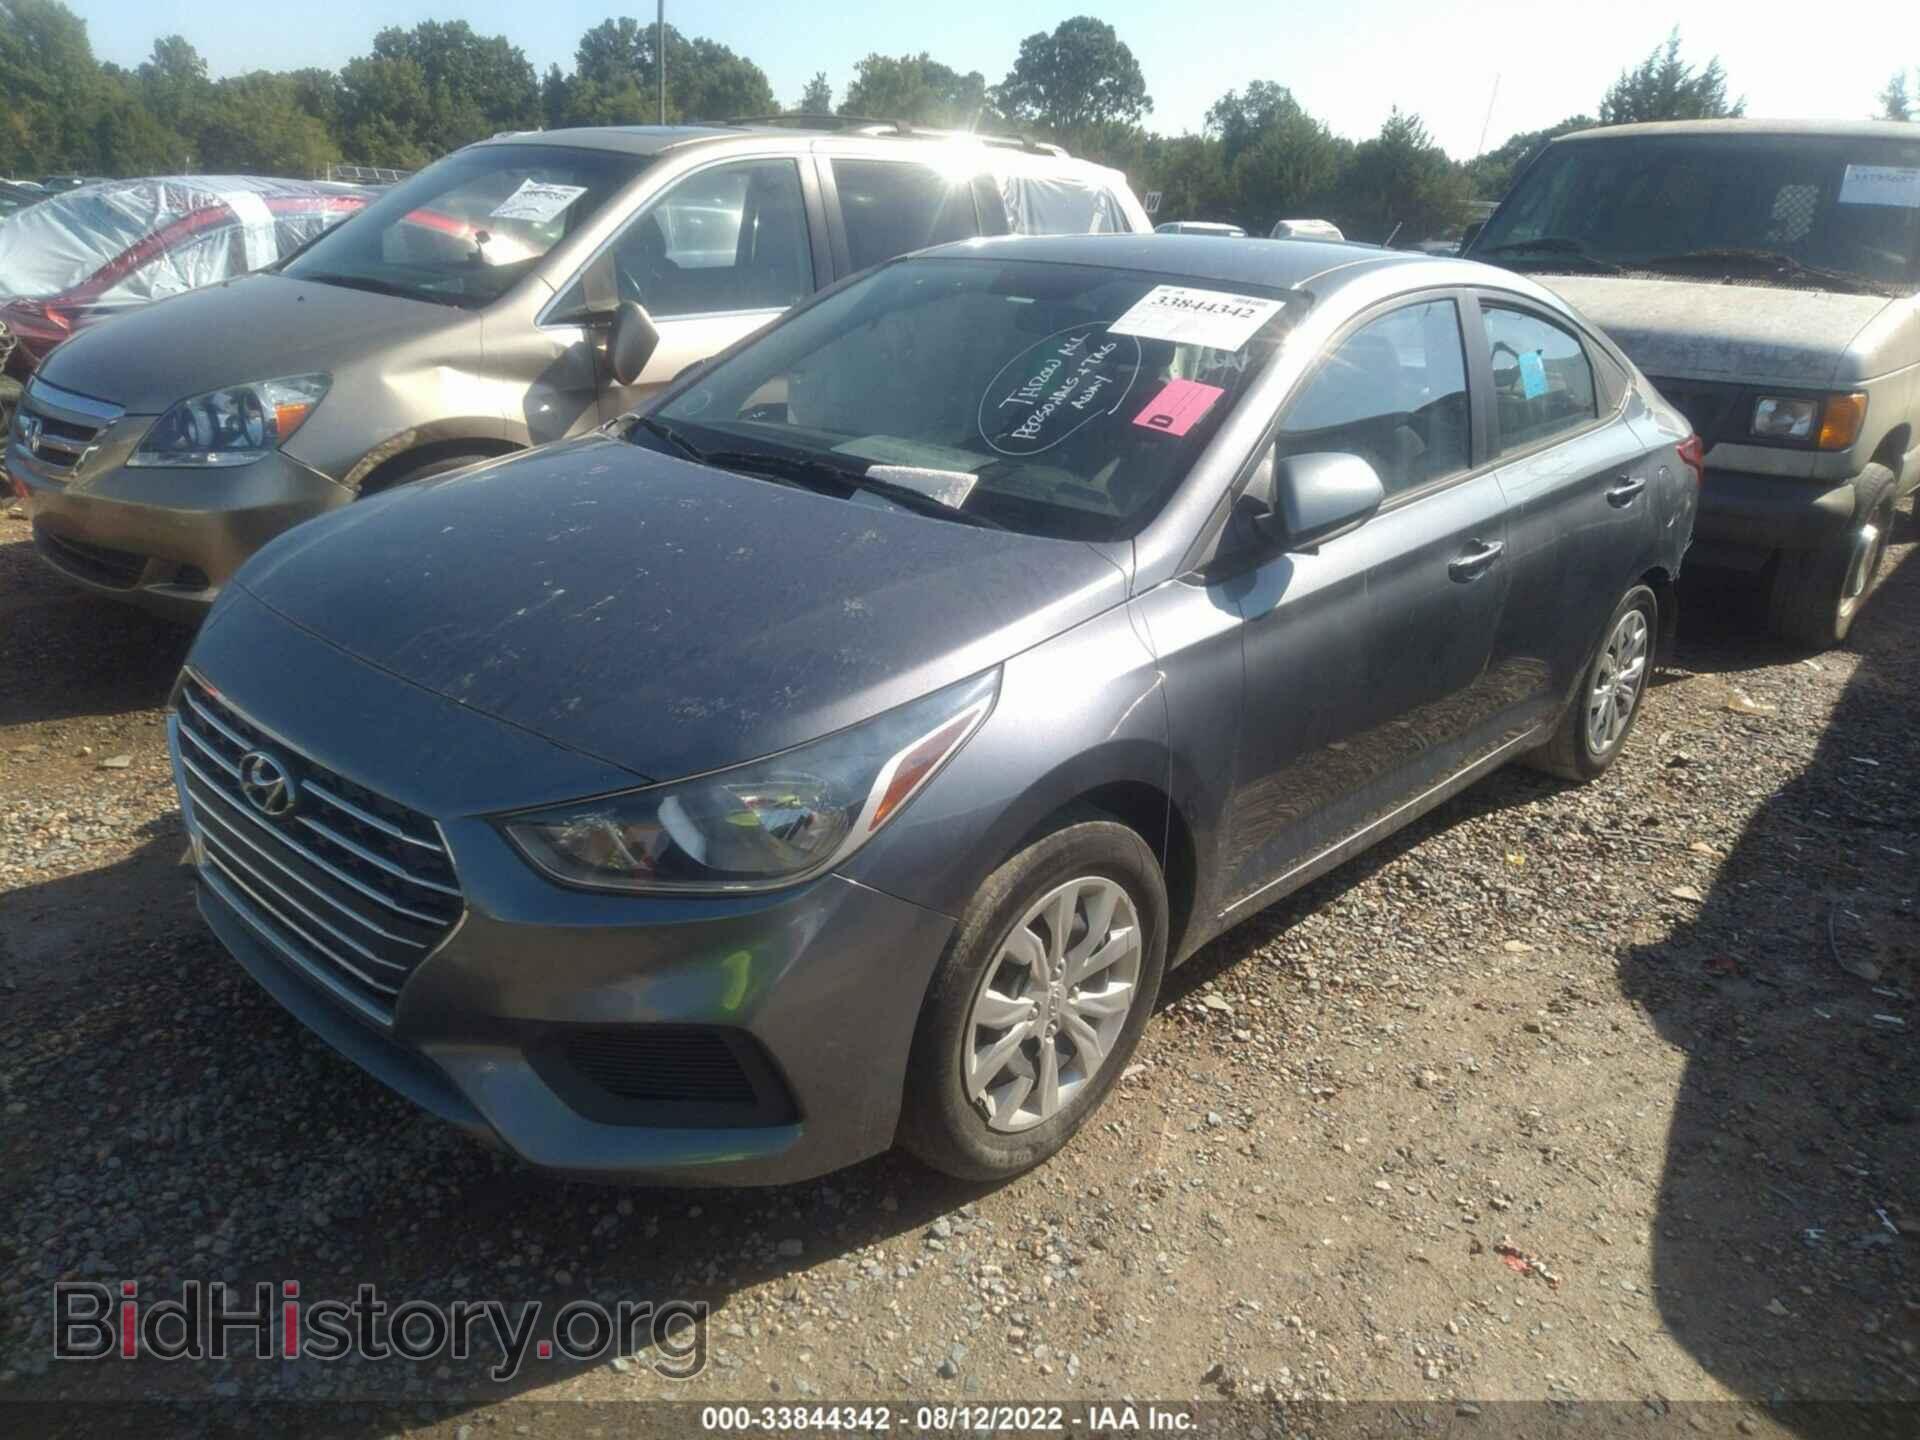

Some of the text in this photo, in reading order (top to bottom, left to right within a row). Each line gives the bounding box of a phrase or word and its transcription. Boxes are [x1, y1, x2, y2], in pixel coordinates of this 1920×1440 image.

[1151, 295, 1256, 319] 33844342
[998, 332, 1092, 409] THROW ALL
